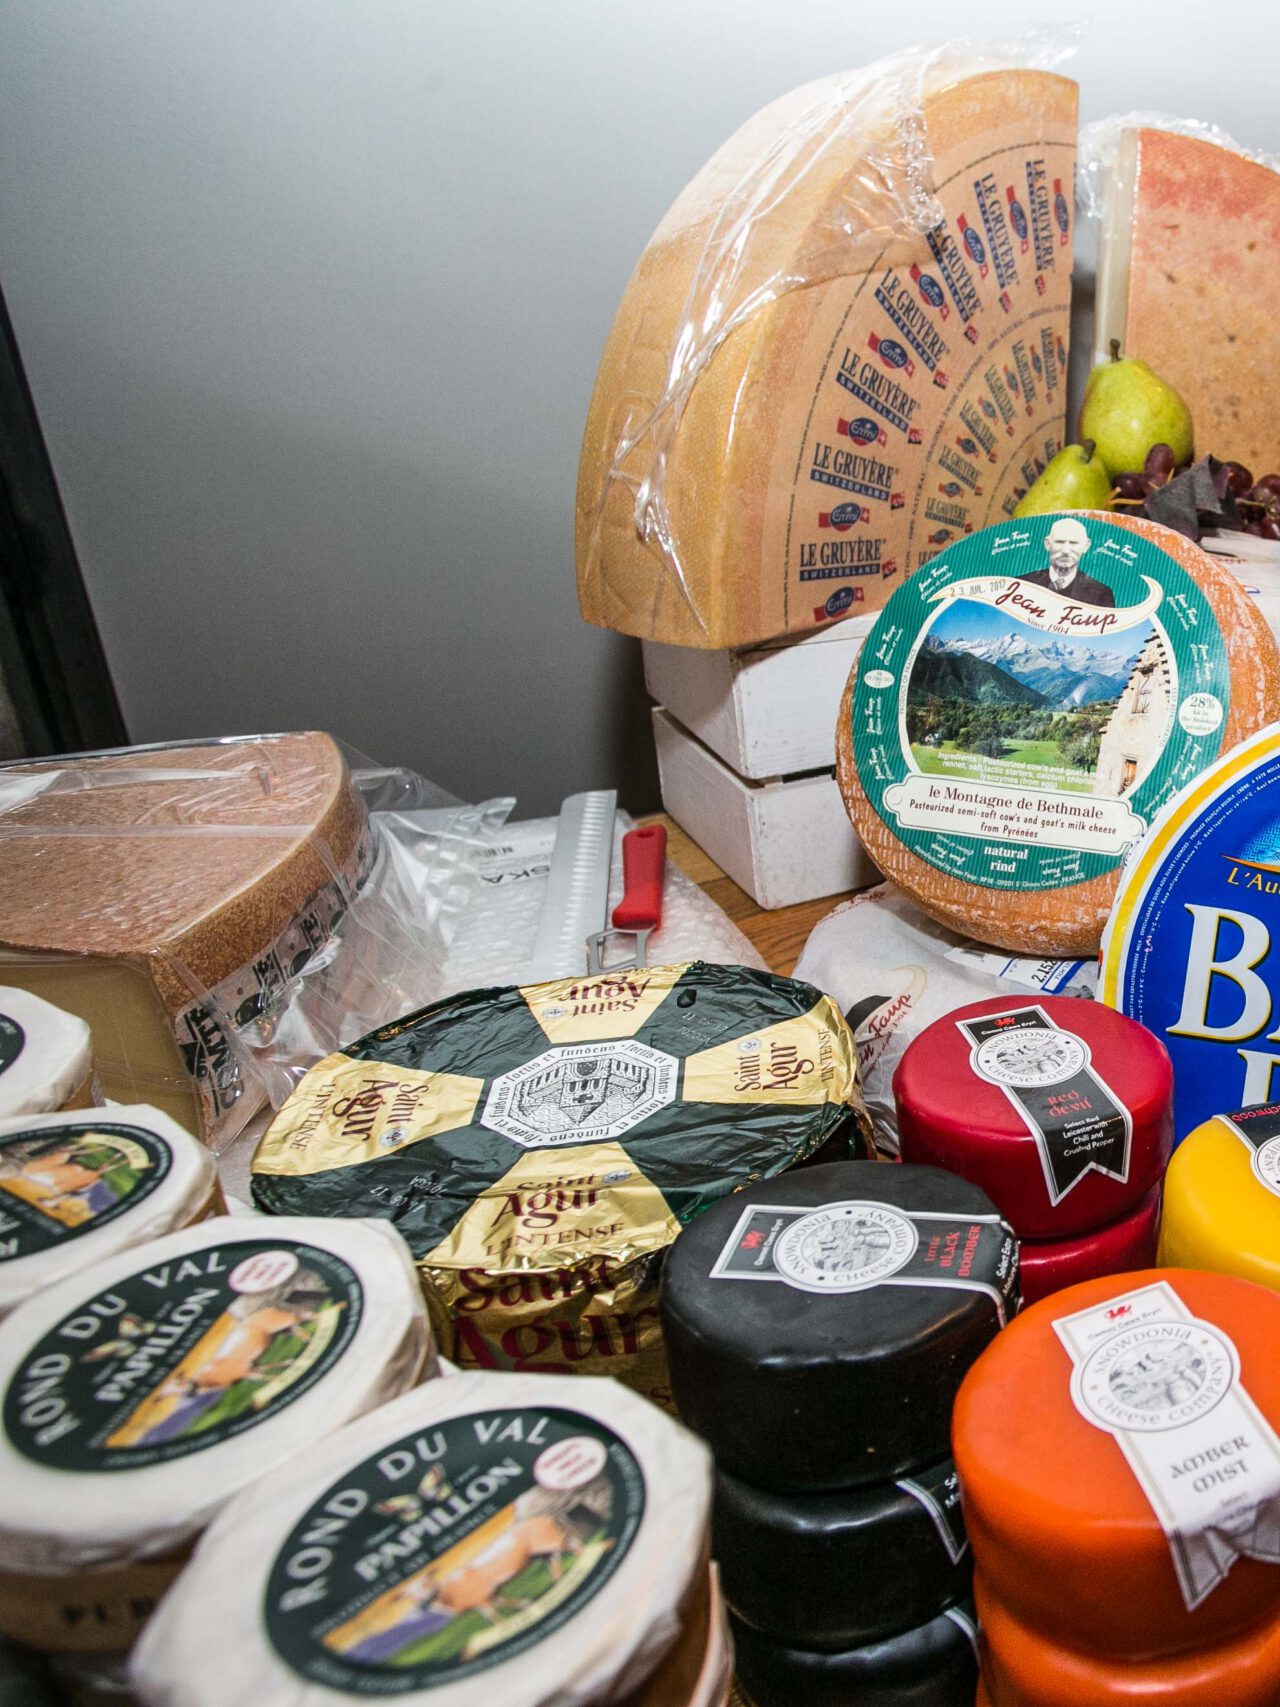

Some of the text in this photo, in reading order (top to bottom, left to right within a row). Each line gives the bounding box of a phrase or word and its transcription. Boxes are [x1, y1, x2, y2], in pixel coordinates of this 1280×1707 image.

[981, 173, 997, 199] LE
[941, 234, 981, 316] GRUYÈRE
[881, 268, 945, 362] LE GRUYÈRE
[840, 348, 915, 420] LE GRUYÈRE
[813, 442, 894, 489] LE GRUYÈRE
[814, 471, 887, 500] SWITZERLAND
[800, 536, 881, 567] LE GRUYÈRE
[802, 566, 879, 579] SWITZERLAND
[996, 581, 1118, 635] Jean Faup
[1026, 616, 1070, 635] Since 1904
[909, 799, 1117, 835] Pasteurized semi-soft cow's and goat's milk cheese
[929, 786, 1104, 820] le Montagne de Bethmale
[980, 822, 999, 834] from
[984, 845, 1029, 860] natural
[990, 860, 1016, 873] rind
[559, 976, 651, 1002] Agur
[572, 999, 638, 1017] Saint
[868, 993, 911, 1037] Faup
[734, 1054, 760, 1092] Saint
[763, 1042, 814, 1090] Agur
[290, 1084, 335, 1151] L'INTENSE
[332, 1079, 399, 1141] Agur
[387, 1083, 428, 1124] Saint
[1064, 1115, 1099, 1129] Select Red
[1063, 1121, 1108, 1138] Leicester with
[1073, 1131, 1103, 1145] Chilli and
[491, 1185, 612, 1229] Agur
[485, 1222, 624, 1257] L'INTENSE
[783, 1214, 831, 1276] SNOWDONIA
[996, 1254, 1008, 1279] Select
[60, 1293, 128, 1339] DU
[143, 1251, 227, 1289] VAL
[97, 1288, 221, 1402] PAPILLON
[1094, 1327, 1192, 1373] SNOWDONIA
[377, 1432, 448, 1482] DU
[473, 1415, 551, 1445] VAL
[354, 1457, 523, 1582] PAPILLON
